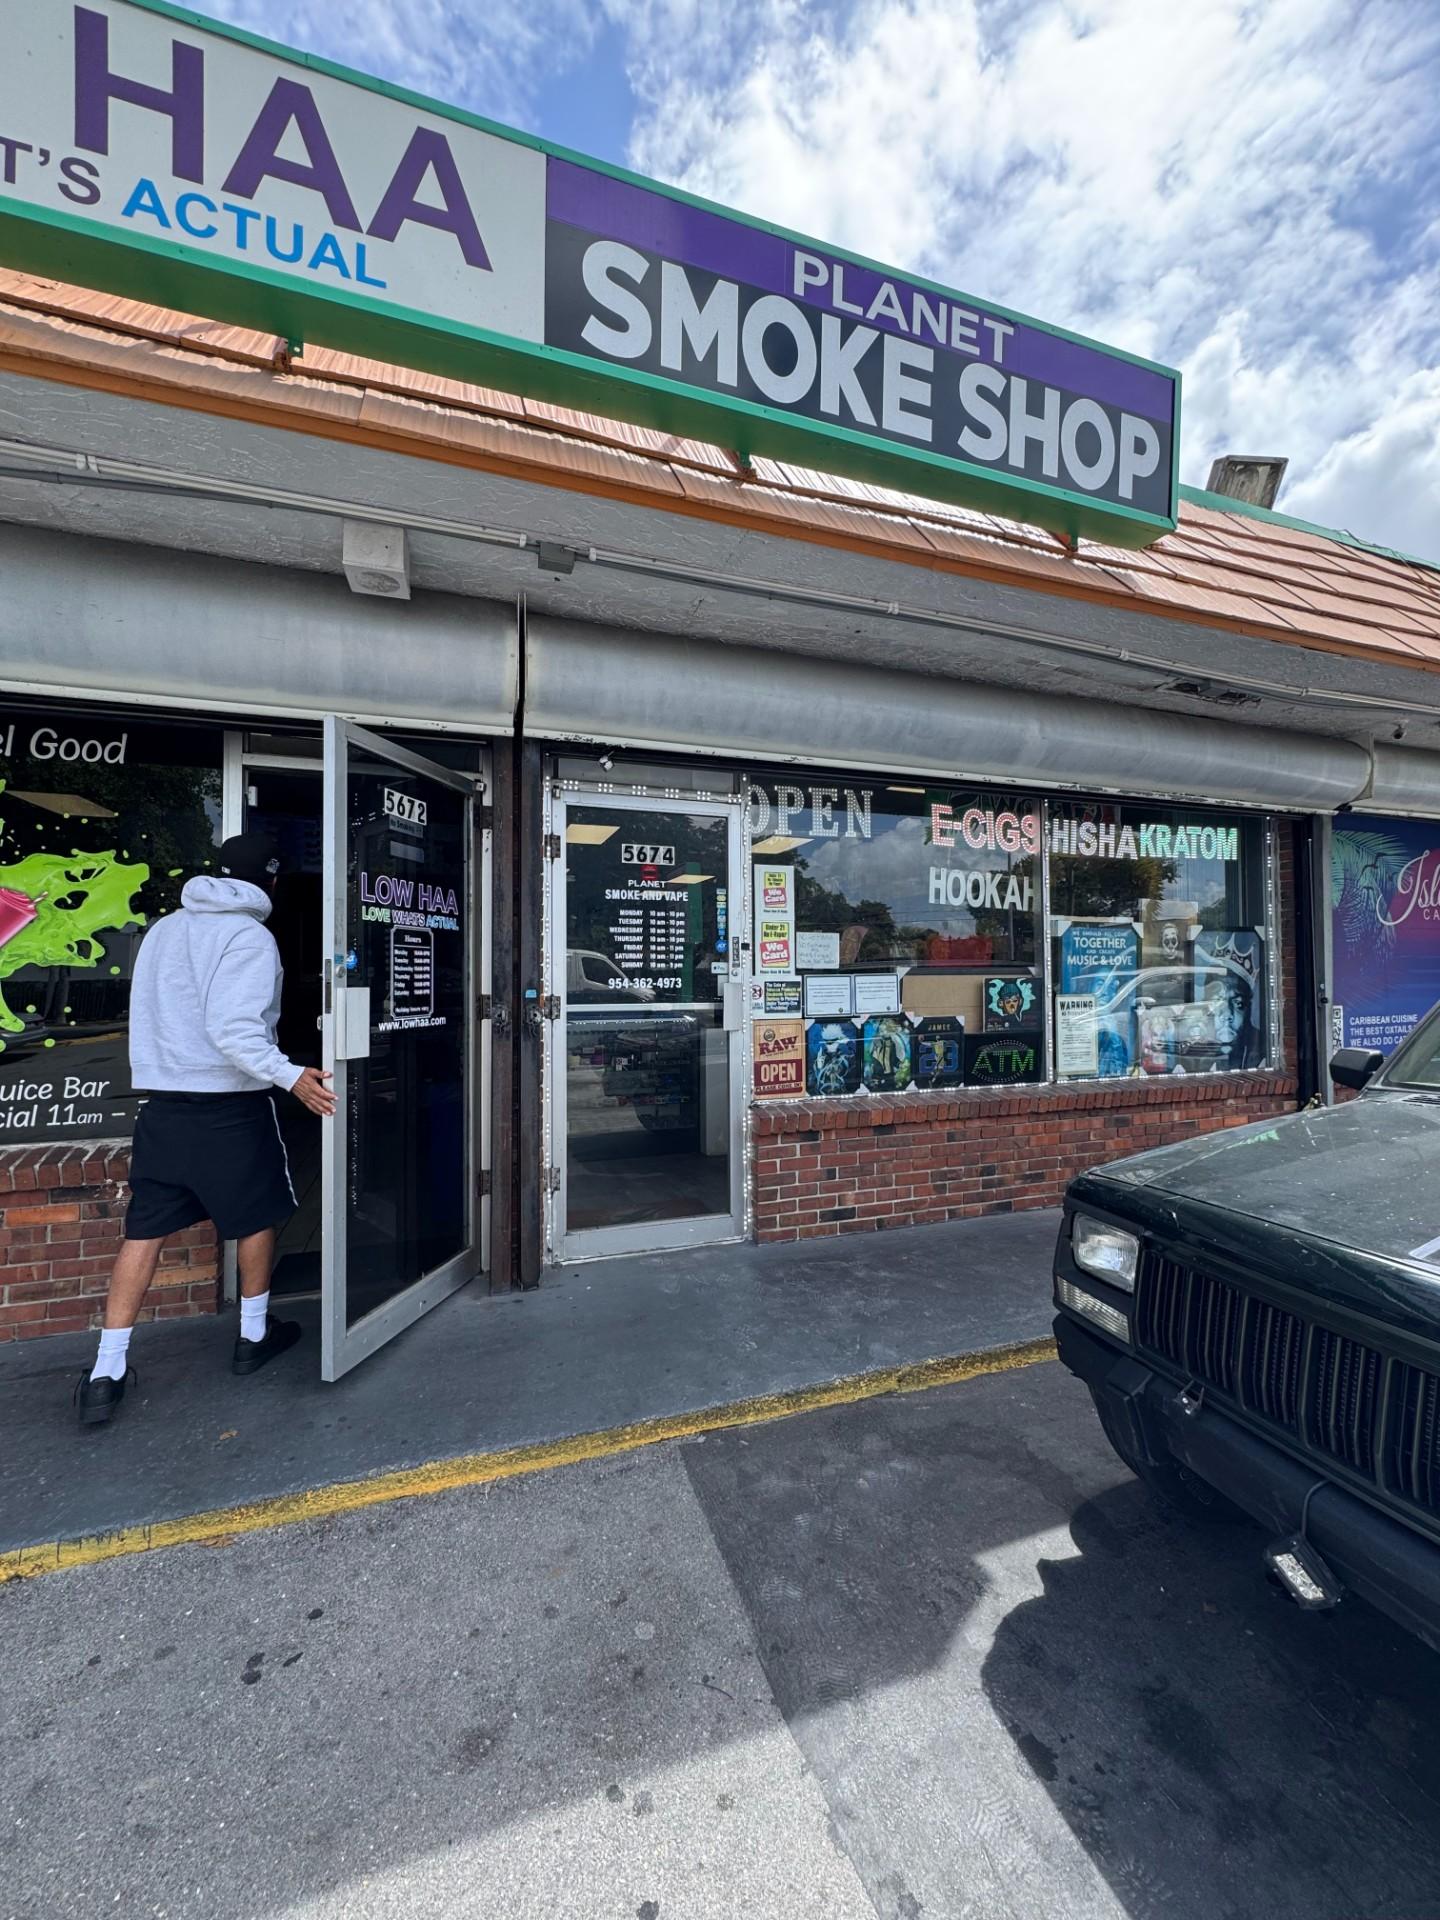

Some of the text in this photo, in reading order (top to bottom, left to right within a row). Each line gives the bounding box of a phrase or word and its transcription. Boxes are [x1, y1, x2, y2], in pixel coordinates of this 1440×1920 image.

[74, 5, 493, 272] HAA
[121, 178, 388, 289] ACTUAL
[793, 250, 1014, 363] PLANET
[580, 240, 1161, 500] SMOKE SHOP
[29, 727, 128, 765] Good
[385, 790, 426, 823] 5672
[747, 784, 873, 838] OPEN
[931, 803, 1041, 854] E-CIGS
[1139, 823, 1238, 861] KRATOM
[623, 845, 674, 865] 5674
[361, 871, 459, 915] LOW HAA
[627, 879, 666, 889] PLANET
[605, 889, 689, 902] SMOKE AND VAPE
[362, 906, 391, 923] LOVE
[425, 914, 460, 931] ACTUAL
[766, 943, 784, 951] We
[1073, 937, 1126, 948] TOGETHER
[762, 950, 788, 960] Card
[1067, 955, 1132, 966] MUSIC & LOVE
[608, 977, 682, 989] 954-362-4973
[1060, 1000, 1093, 1011] WARNING
[378, 1016, 446, 1032] www.lowhaa.com
[1349, 1014, 1418, 1026] CARIBBEAN CUISINE
[1350, 1027, 1364, 1036] THE
[1366, 1026, 1383, 1035] BEST
[1385, 1025, 1412, 1034] OXTAILS
[759, 1036, 799, 1055] RAW
[1363, 1037, 1381, 1046] ALSO
[971, 1049, 1035, 1074] ATM
[760, 1062, 797, 1083] OPEN
[63, 1076, 110, 1099] Bar
[46, 1103, 103, 1126] 11am
